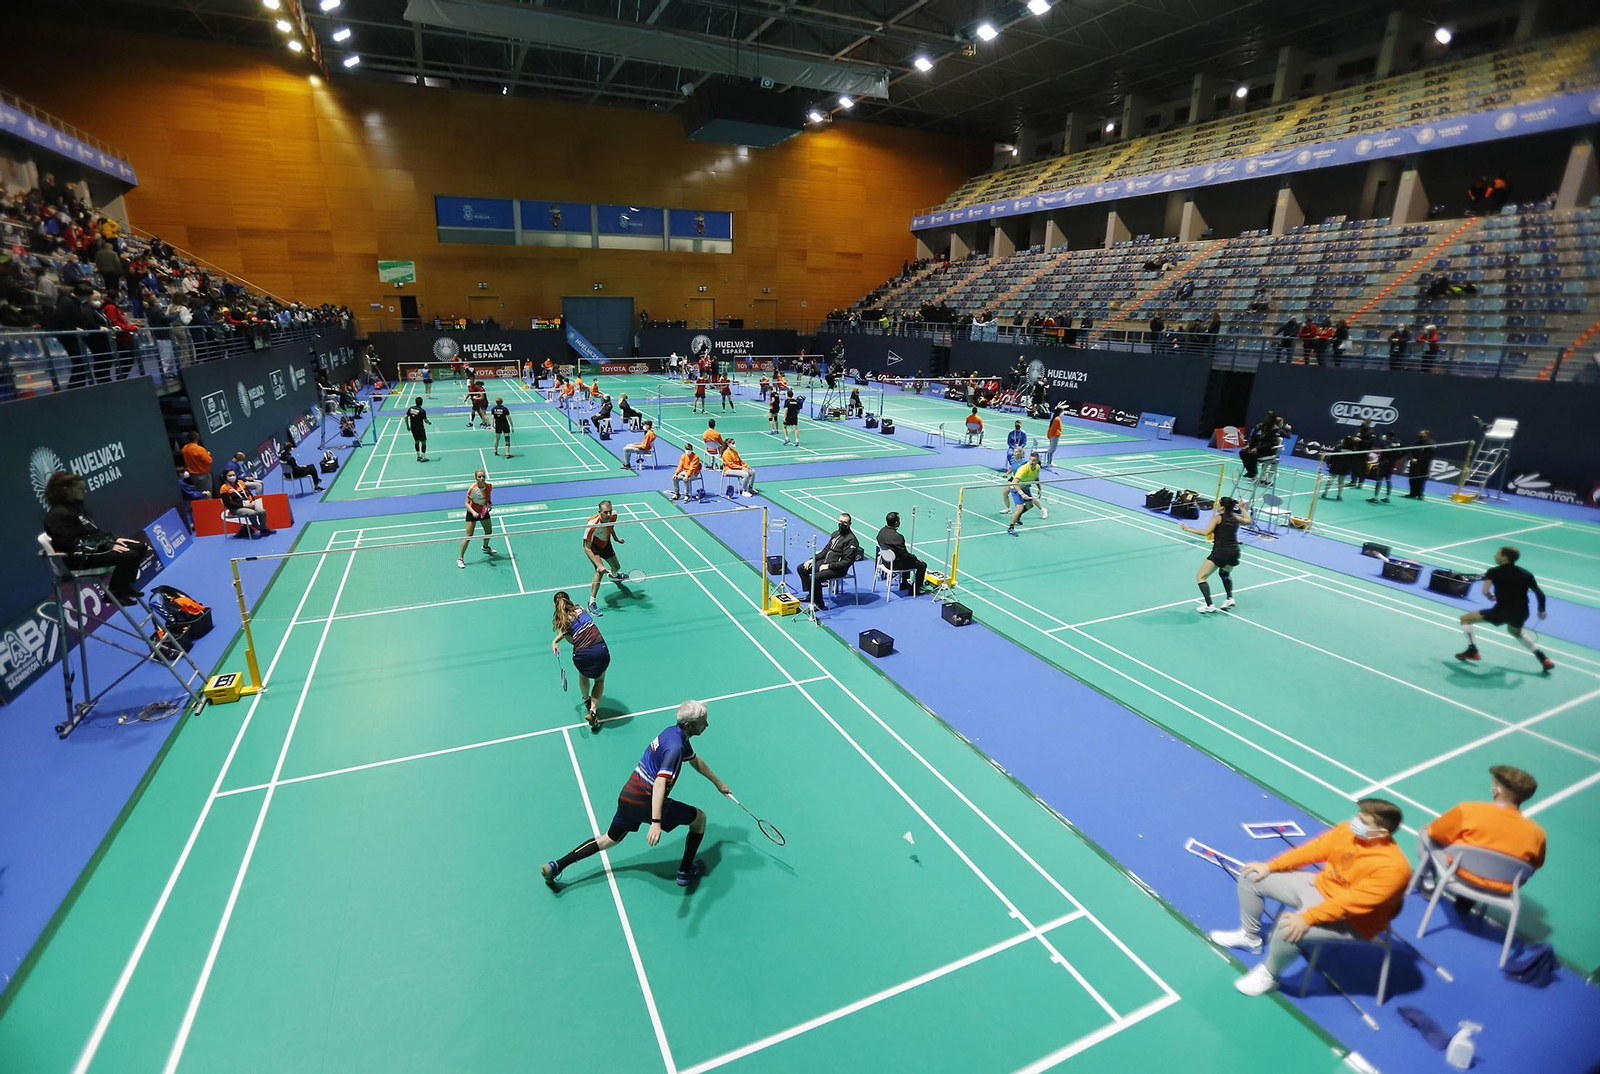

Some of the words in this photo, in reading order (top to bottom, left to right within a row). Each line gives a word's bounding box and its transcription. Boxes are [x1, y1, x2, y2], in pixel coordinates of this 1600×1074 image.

[463, 343, 513, 353] HUELVA'21
[715, 340, 754, 349] HUELVA'21
[722, 347, 747, 355] ESPAÑA
[1047, 369, 1088, 382] HUELVA'21
[1052, 380, 1078, 389] ESPAÑA
[69, 441, 126, 477] HUELVA'21
[87, 465, 123, 491] ESPAÑA
